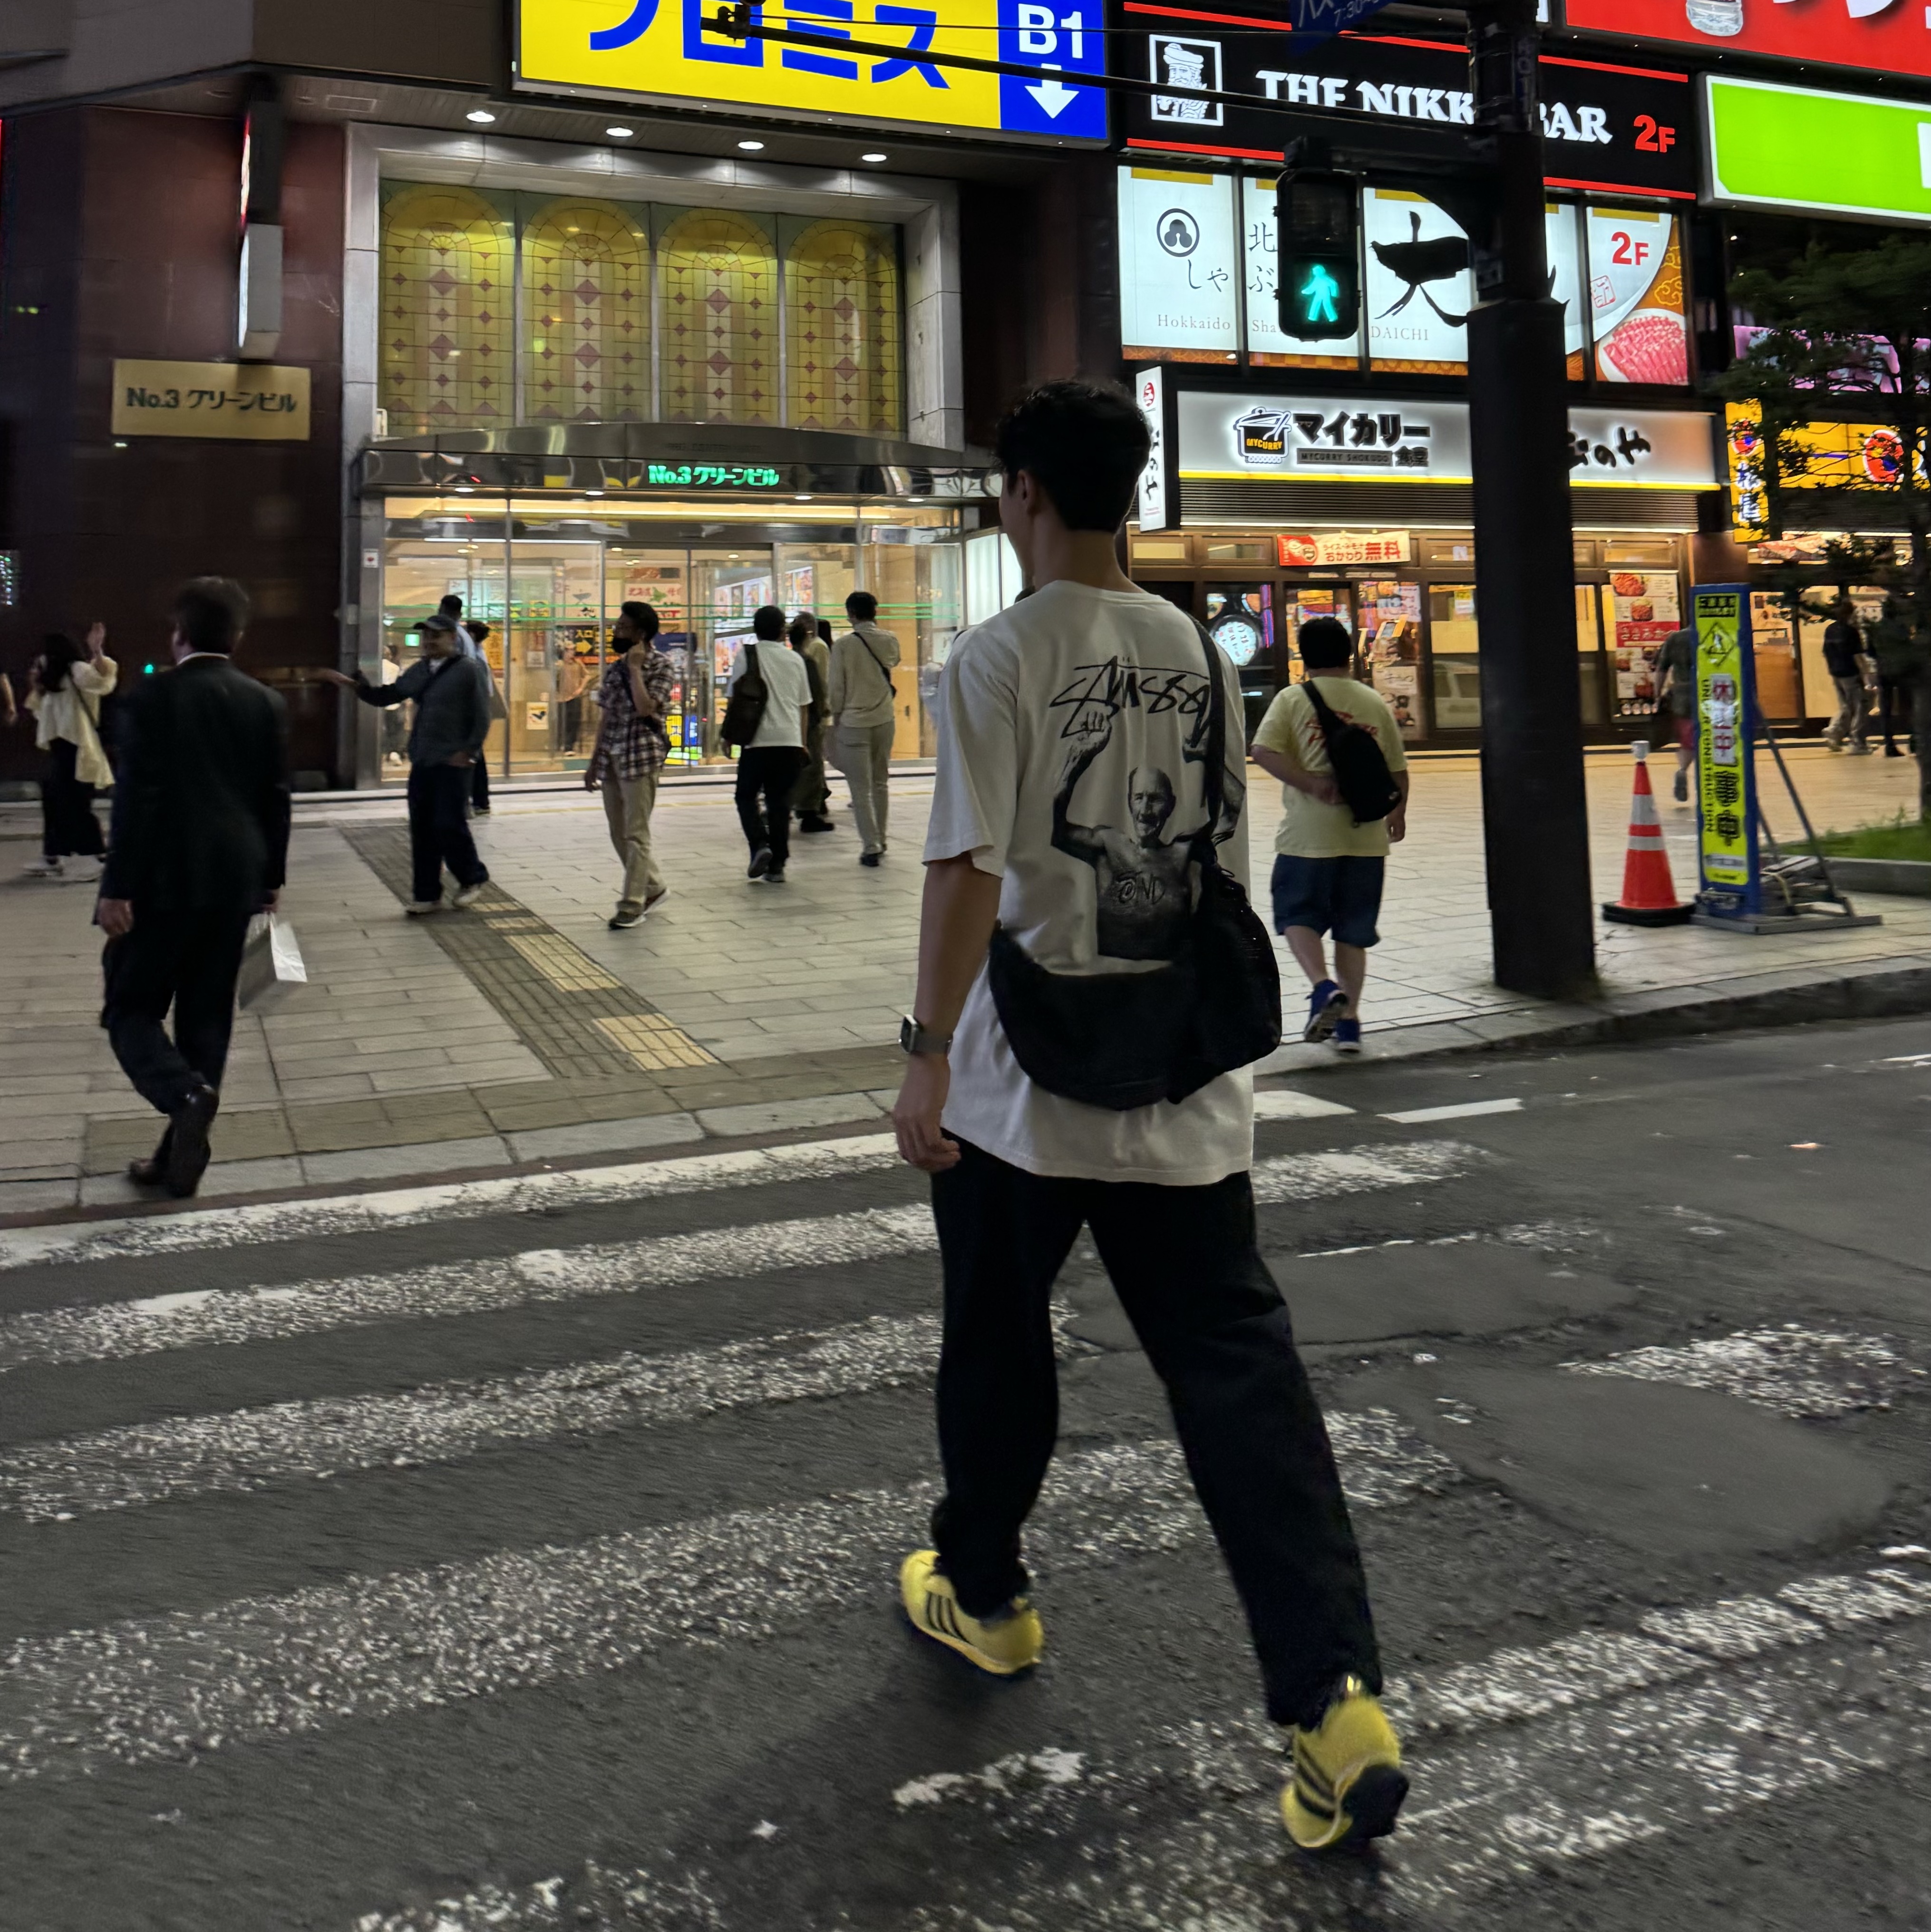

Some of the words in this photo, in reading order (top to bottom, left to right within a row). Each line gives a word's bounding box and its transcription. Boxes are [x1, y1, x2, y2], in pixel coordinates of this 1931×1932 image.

[1018, 3, 1083, 58] B1
[1255, 70, 1349, 107] THE
[1356, 80, 1474, 125] NIKK
[1633, 115, 1675, 153] 2F
[1611, 232, 1649, 266] 2F
[1158, 314, 1231, 330] Hokkaido
[1371, 326, 1429, 341] DAICHI
[126, 387, 180, 408] No.3
[1246, 437, 1283, 451] MYCURRY
[1293, 411, 1430, 448] マイカリー
[648, 465, 691, 485] No.3
[693, 466, 780, 486] グリーンビル
